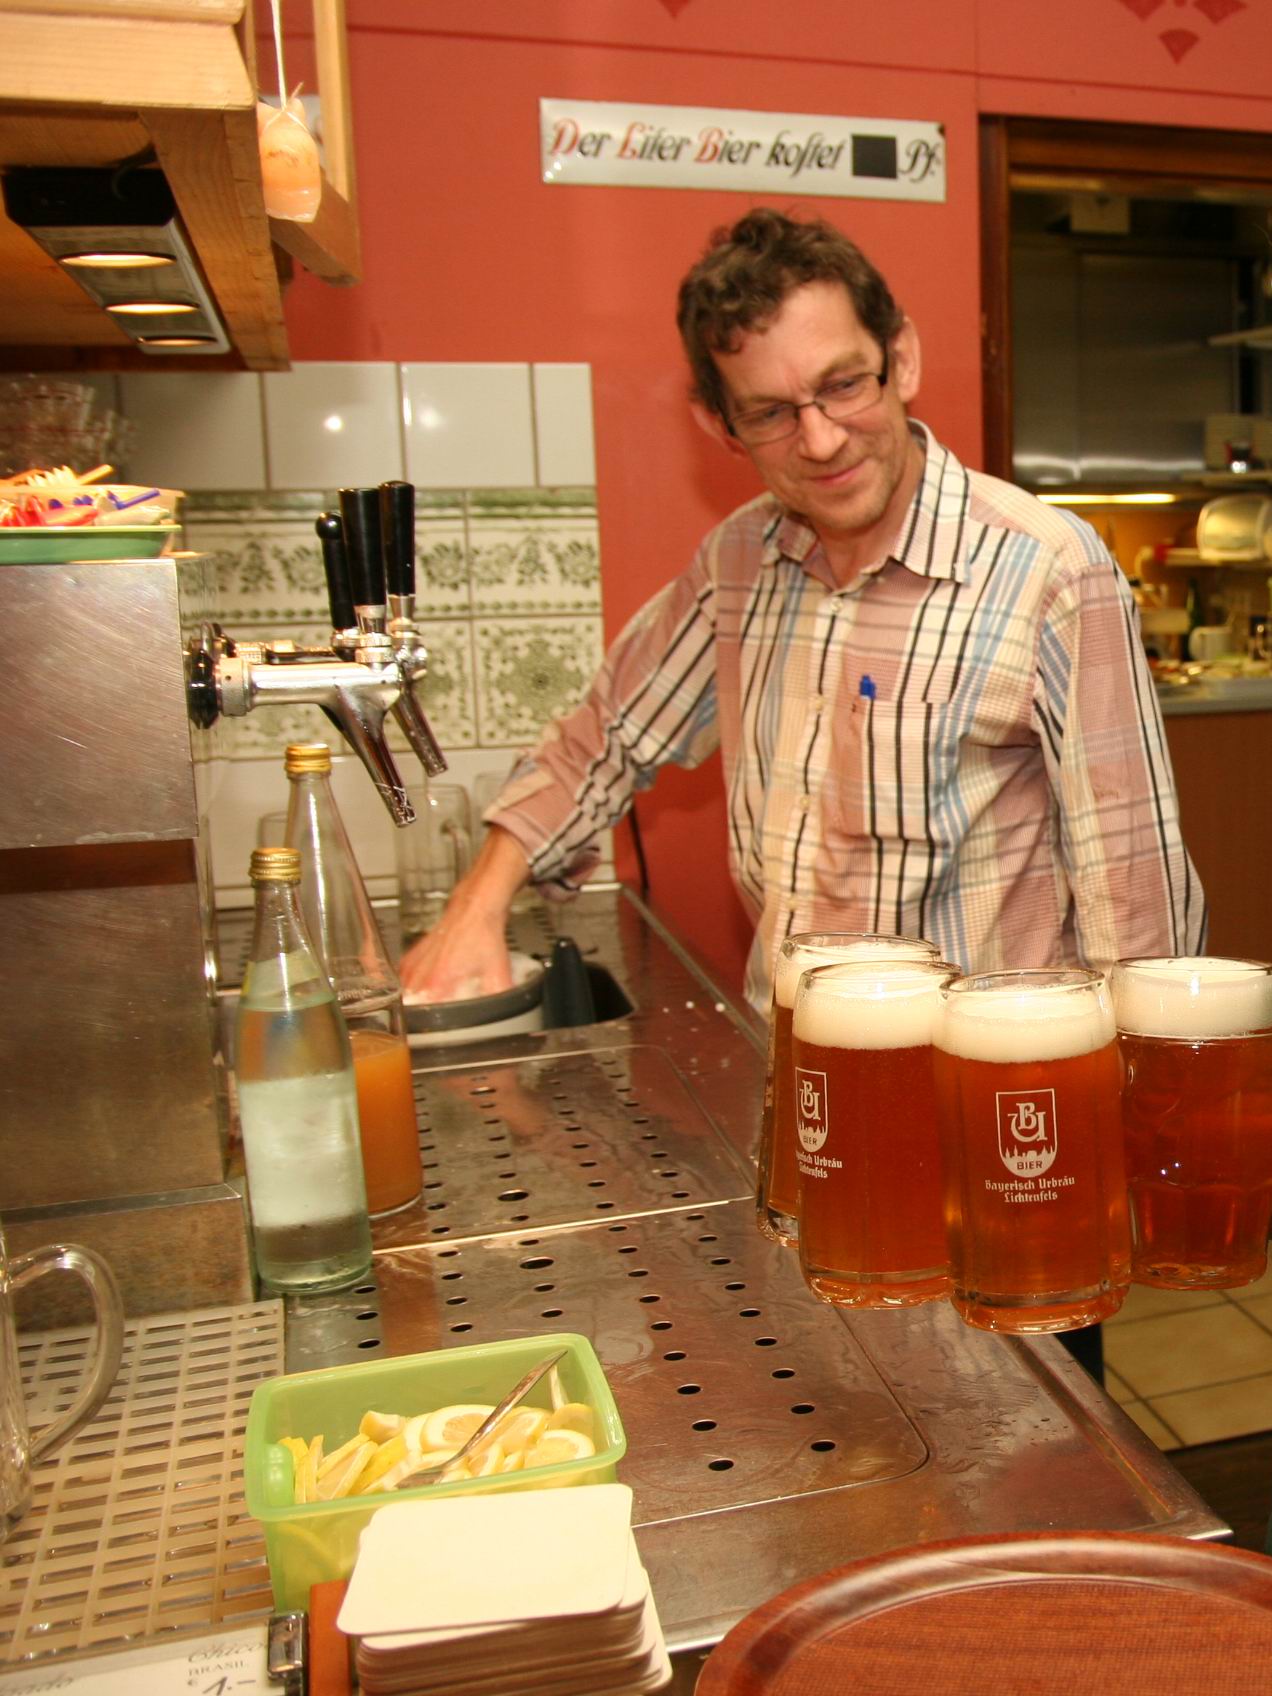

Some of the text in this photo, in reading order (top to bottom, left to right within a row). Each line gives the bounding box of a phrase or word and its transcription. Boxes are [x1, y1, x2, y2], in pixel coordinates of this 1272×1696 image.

[548, 117, 609, 157] Der
[617, 121, 691, 162] Liter
[694, 127, 760, 167] Bier
[1017, 1160, 1043, 1171] BIER
[985, 1175, 1076, 1192] Bayerisch Urbräu
[1004, 1190, 1058, 1203] Lichtenfels
